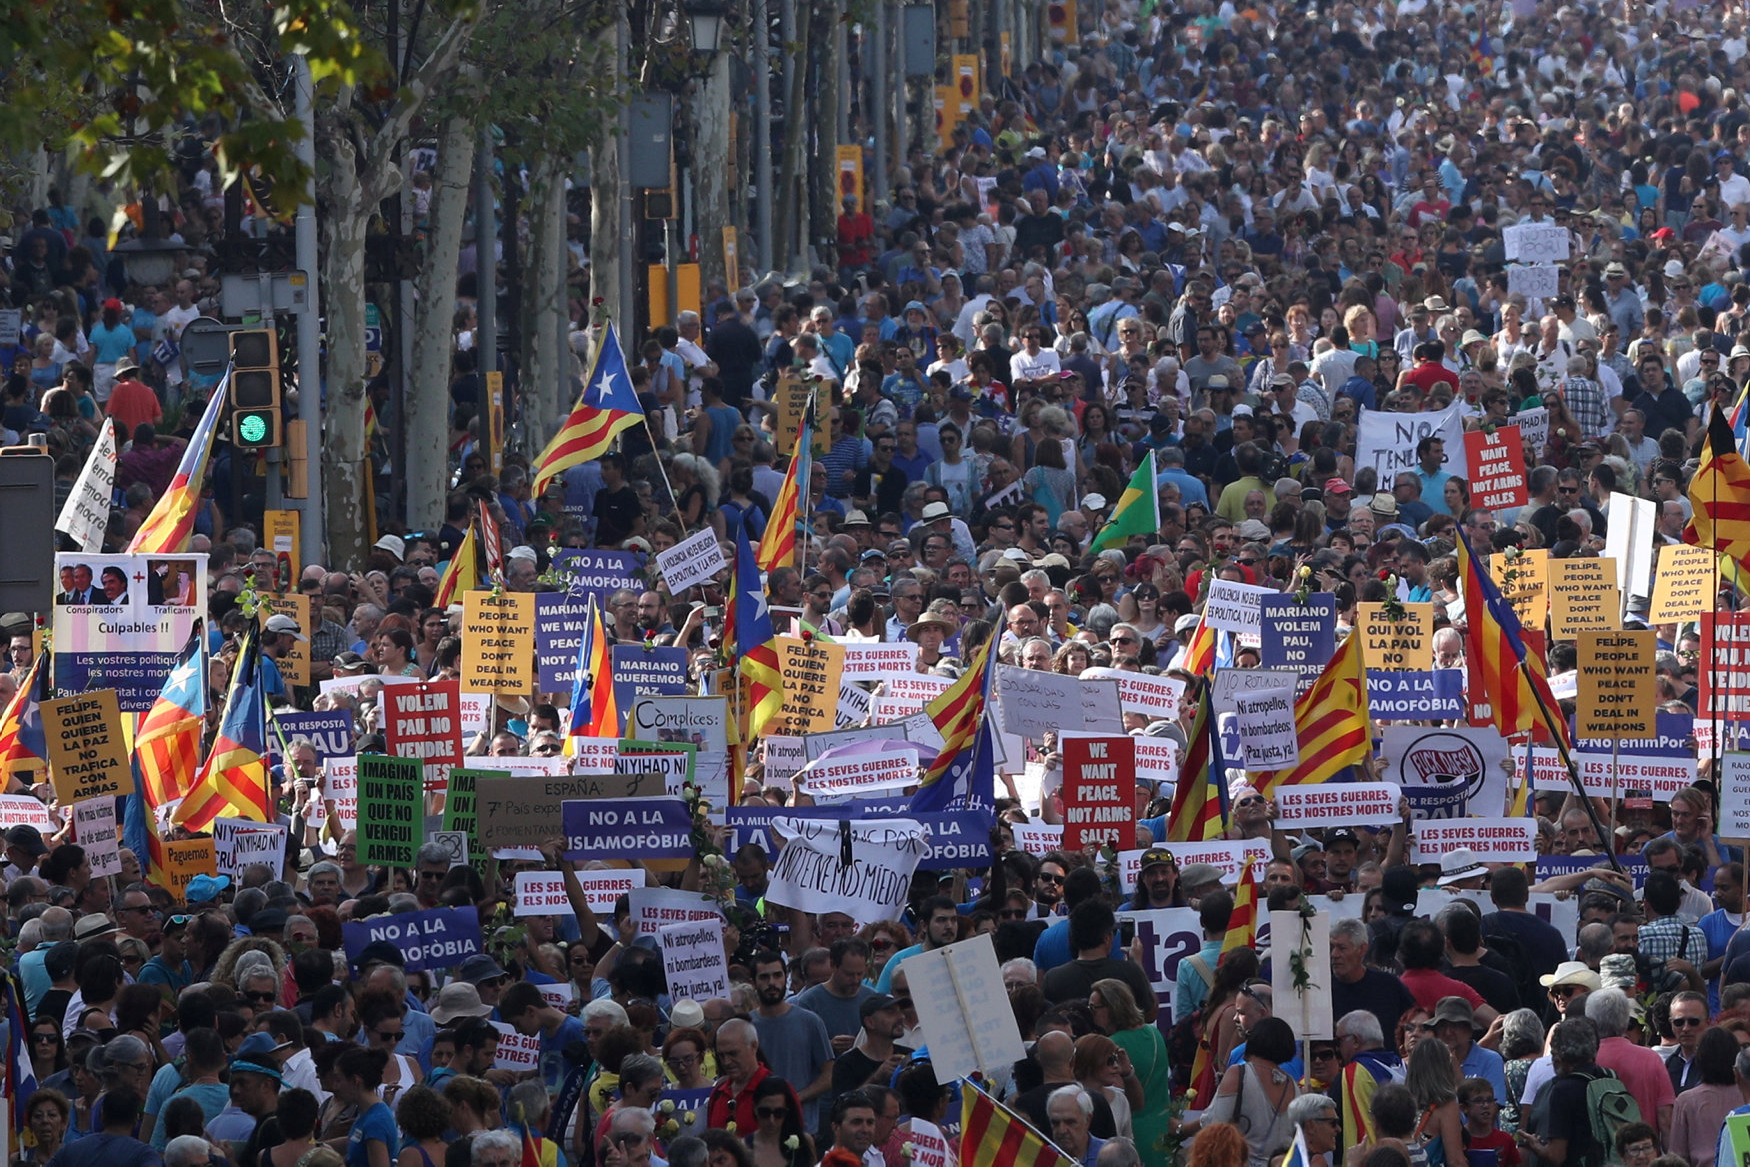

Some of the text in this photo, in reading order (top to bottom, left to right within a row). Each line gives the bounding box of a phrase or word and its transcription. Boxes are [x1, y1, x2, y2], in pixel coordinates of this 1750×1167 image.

[66, 605, 124, 616] Conspiradors
[154, 606, 196, 615] Traficants
[98, 622, 157, 635] Culpables
[1367, 625, 1424, 636] QUI VOL
[1370, 639, 1420, 649] LA PAU
[1596, 638, 1638, 648] FELIPE,
[77, 655, 137, 665] Les vostres
[1382, 654, 1403, 663] NO
[1594, 653, 1638, 661] PEOPLE
[88, 667, 172, 677] les nostres mort
[1583, 666, 1650, 675] WHO WANT
[1366, 679, 1434, 692] NO A LA
[1597, 680, 1636, 689] PEACE
[1598, 694, 1634, 703] DON'T
[57, 701, 102, 717] FELIPE,
[1594, 709, 1638, 717] DEAL IN
[62, 712, 102, 727] QUIEN
[1586, 723, 1646, 731] WEAPONS
[62, 723, 108, 740] QUIERE
[64, 736, 110, 752] LA PAZ
[1089, 742, 1108, 759] WE
[80, 749, 98, 761] NO
[64, 760, 118, 776] TRAFICA
[363, 761, 418, 782] IMAGINA
[807, 765, 861, 780] LES SEVES
[1080, 763, 1117, 780] WANT
[80, 773, 107, 785] CON
[808, 769, 913, 790] ELS NOSTRES MORTS
[73, 783, 118, 799] ARMAS
[366, 782, 414, 801] UN PAÍS
[1078, 785, 1121, 802] PEACE,
[1282, 789, 1392, 805] LES SEVES GUERRES,
[368, 803, 412, 823] QUE NO
[590, 811, 664, 825] NO A LA
[1067, 806, 1132, 823] NOT ARMS
[1282, 803, 1393, 819] ELS NOSTRES MORTS
[365, 823, 412, 842] VENGUI
[568, 829, 692, 850] ISLAMOFÒBIA
[1080, 829, 1120, 845] SALES
[884, 829, 918, 855] POR
[368, 843, 412, 863] ARMES
